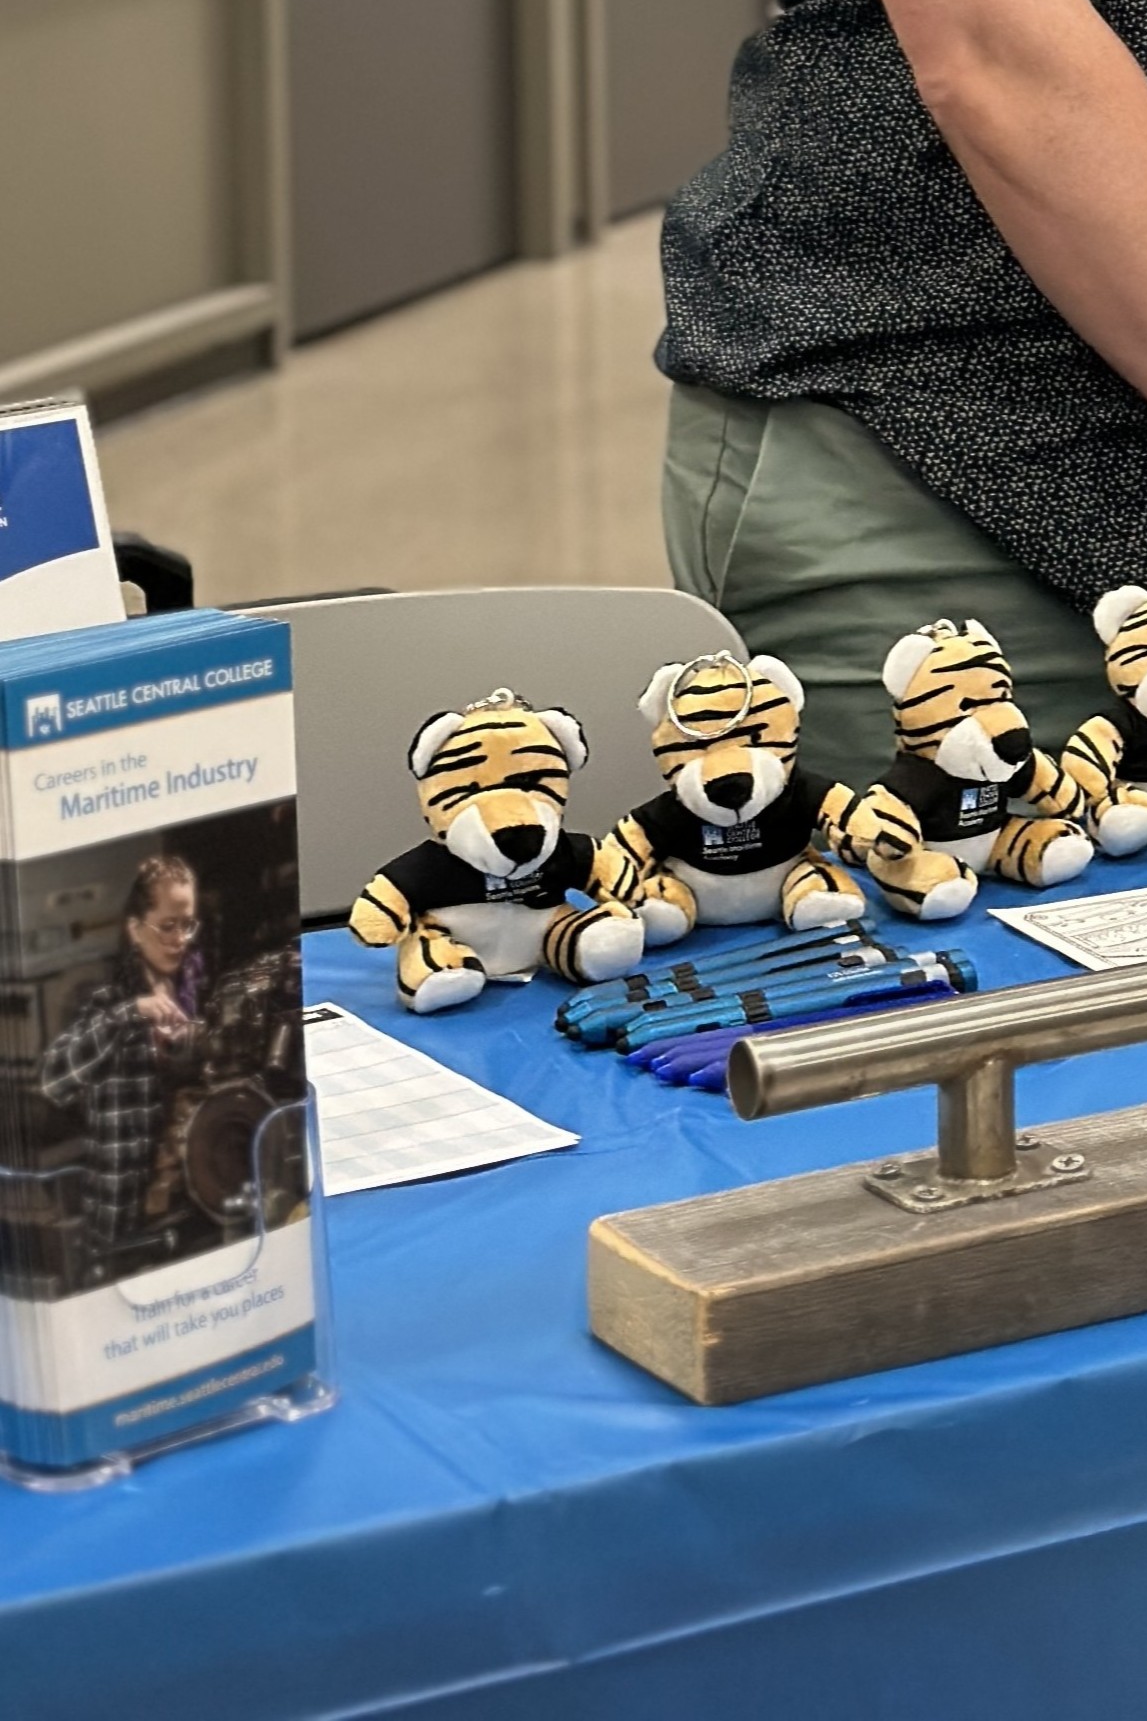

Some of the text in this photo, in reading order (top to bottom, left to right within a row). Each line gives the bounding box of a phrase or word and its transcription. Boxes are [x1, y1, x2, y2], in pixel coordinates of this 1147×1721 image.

[66, 659, 273, 719] SEATTLE CENTRAL COLLEGE
[34, 752, 148, 791] Careers in the
[60, 756, 258, 820] Maritime Industry
[104, 1284, 285, 1360] that will take you places
